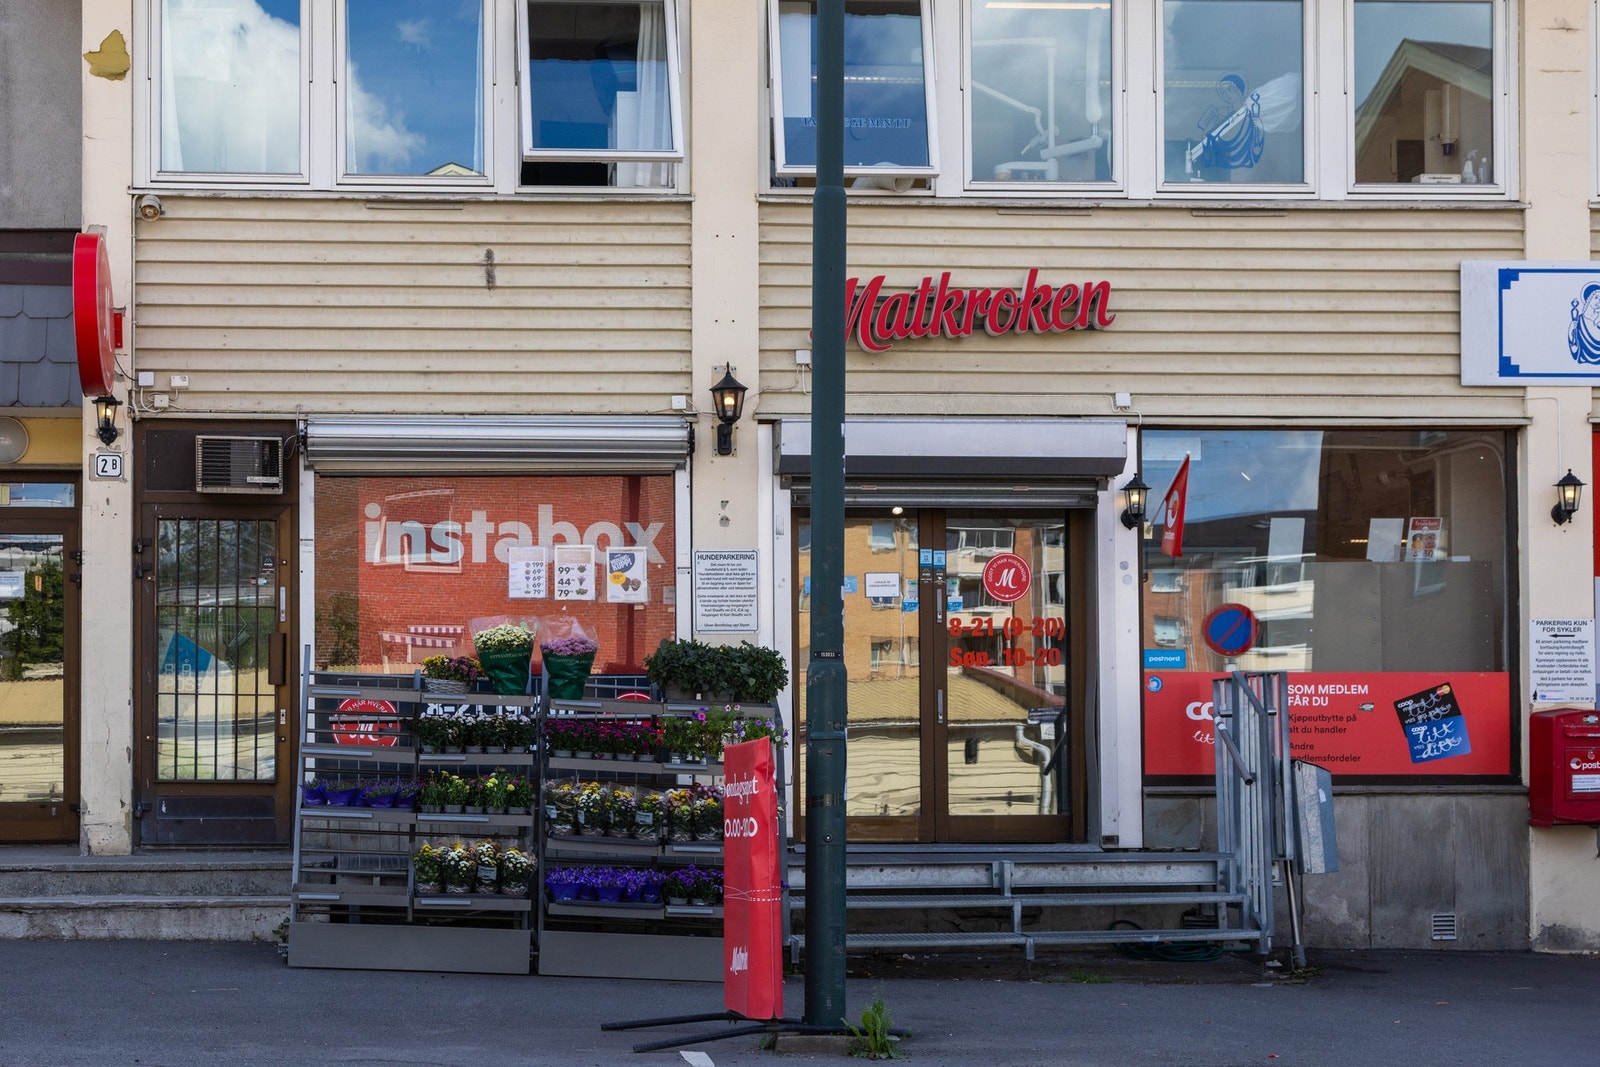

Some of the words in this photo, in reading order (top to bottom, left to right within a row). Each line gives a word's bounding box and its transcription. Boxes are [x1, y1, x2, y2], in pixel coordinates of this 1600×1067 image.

[810, 267, 1116, 353] Matkroken
[364, 503, 666, 564] instabox
[949, 617, 994, 636] 8-21
[1003, 617, 1066, 640] (9-20)
[949, 647, 988, 667] Søn
[1002, 648, 1062, 666] 10-20
[1288, 684, 1314, 694] SOM
[1318, 684, 1368, 694] MEDLEM
[1288, 694, 1310, 706] FÅR
[1312, 696, 1328, 706] DU
[1288, 714, 1344, 723] Kjøpeutbytte
[1346, 714, 1356, 723] på
[1288, 726, 1298, 734] alt
[1301, 726, 1312, 734] du
[1314, 726, 1346, 734] handler
[1290, 742, 1314, 750] Andre
